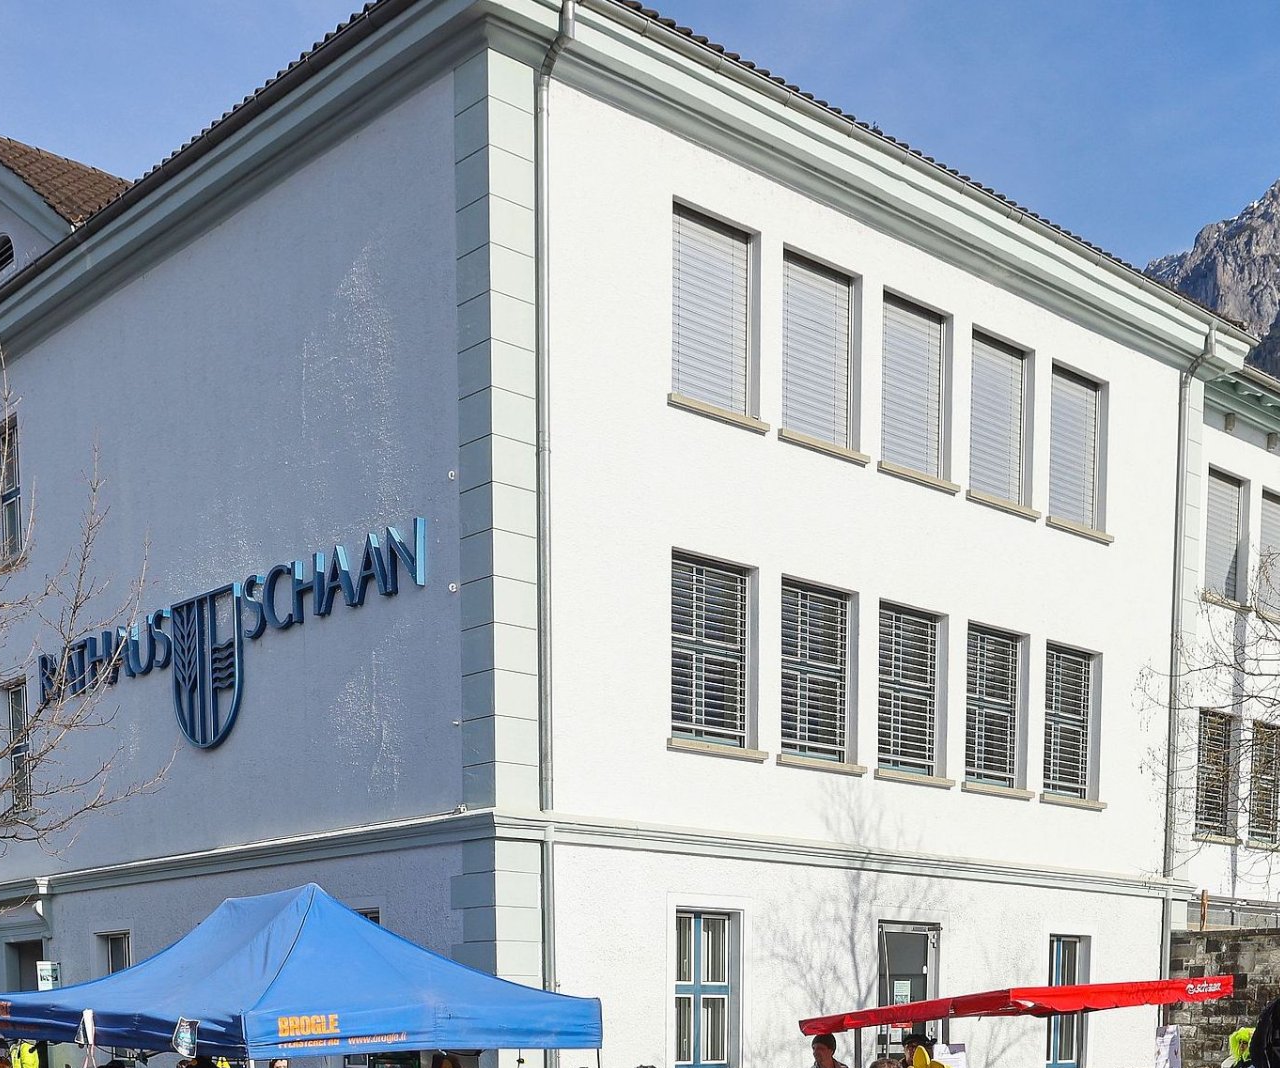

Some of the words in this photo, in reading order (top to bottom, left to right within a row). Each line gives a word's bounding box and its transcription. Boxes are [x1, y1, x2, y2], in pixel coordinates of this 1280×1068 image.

[38, 608, 171, 703] RATHAUS
[243, 516, 426, 640] SCHAAN
[278, 1013, 340, 1037] BROGLE
